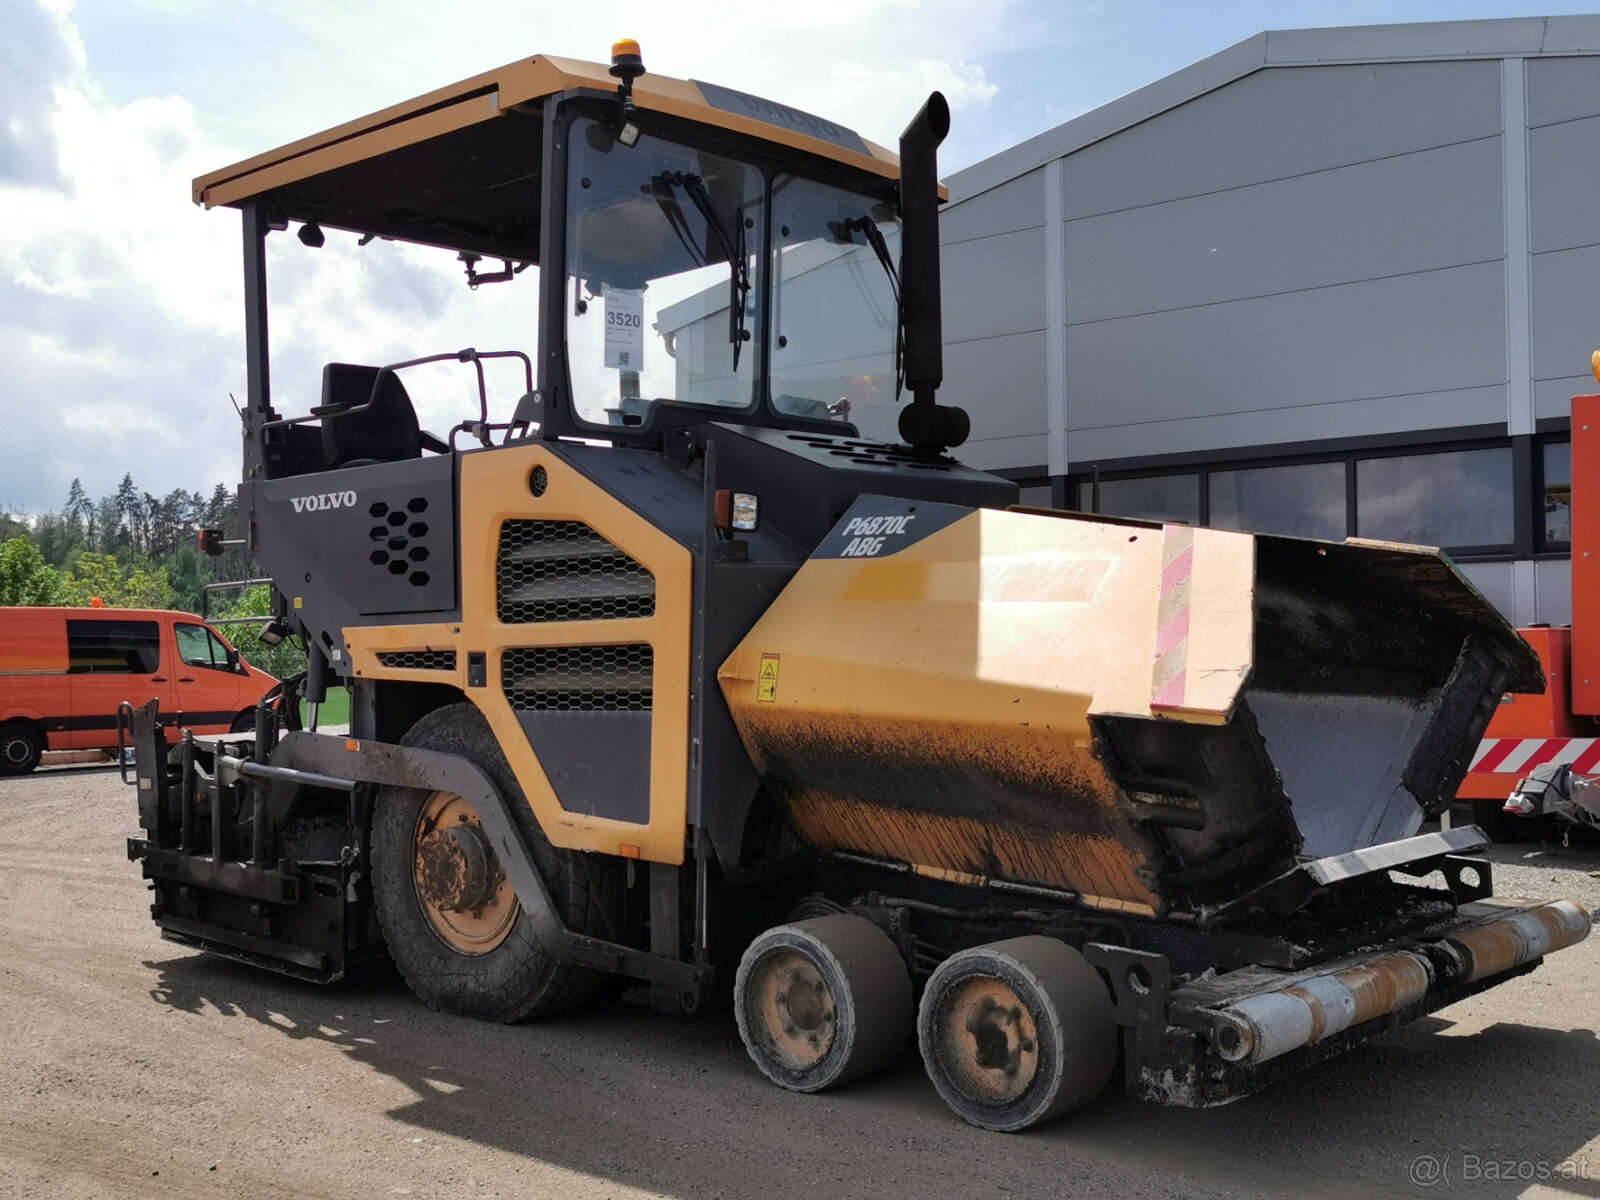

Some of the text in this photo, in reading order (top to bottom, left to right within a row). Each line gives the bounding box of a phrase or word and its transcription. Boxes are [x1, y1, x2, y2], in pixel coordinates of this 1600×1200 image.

[607, 311, 641, 328] 3520
[290, 490, 357, 513] VOLVO
[841, 514, 916, 536] P6870C
[840, 536, 887, 557] ABG
